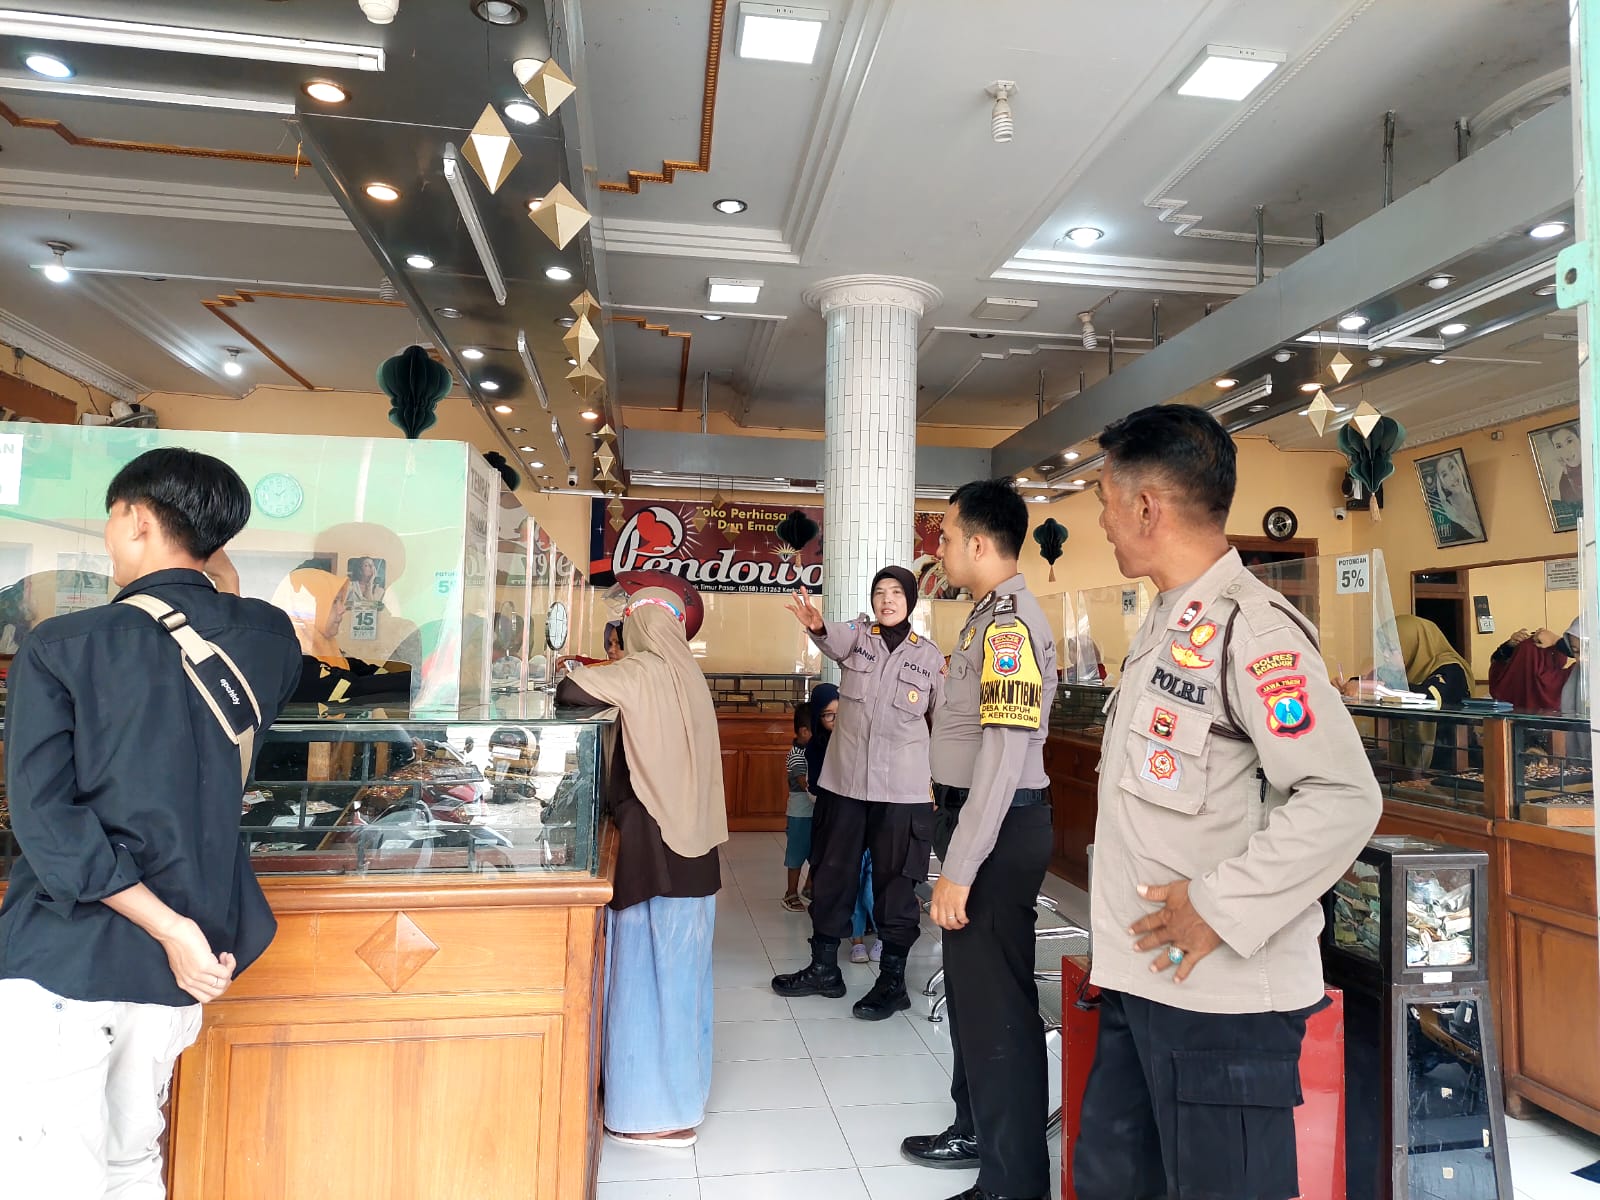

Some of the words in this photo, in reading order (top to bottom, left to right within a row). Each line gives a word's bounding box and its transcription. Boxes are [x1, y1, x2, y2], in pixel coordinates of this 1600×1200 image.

[1341, 569, 1365, 588] 5%
[356, 612, 374, 626] 15
[903, 661, 931, 678] POLRI
[1252, 653, 1293, 671] POLRES
[1150, 666, 1208, 705] POLRI
[1263, 682, 1281, 693] JAWA
[981, 704, 999, 712] DESA
[1002, 704, 1031, 713] KEPUH
[988, 712, 1038, 723] KERTOSONO
